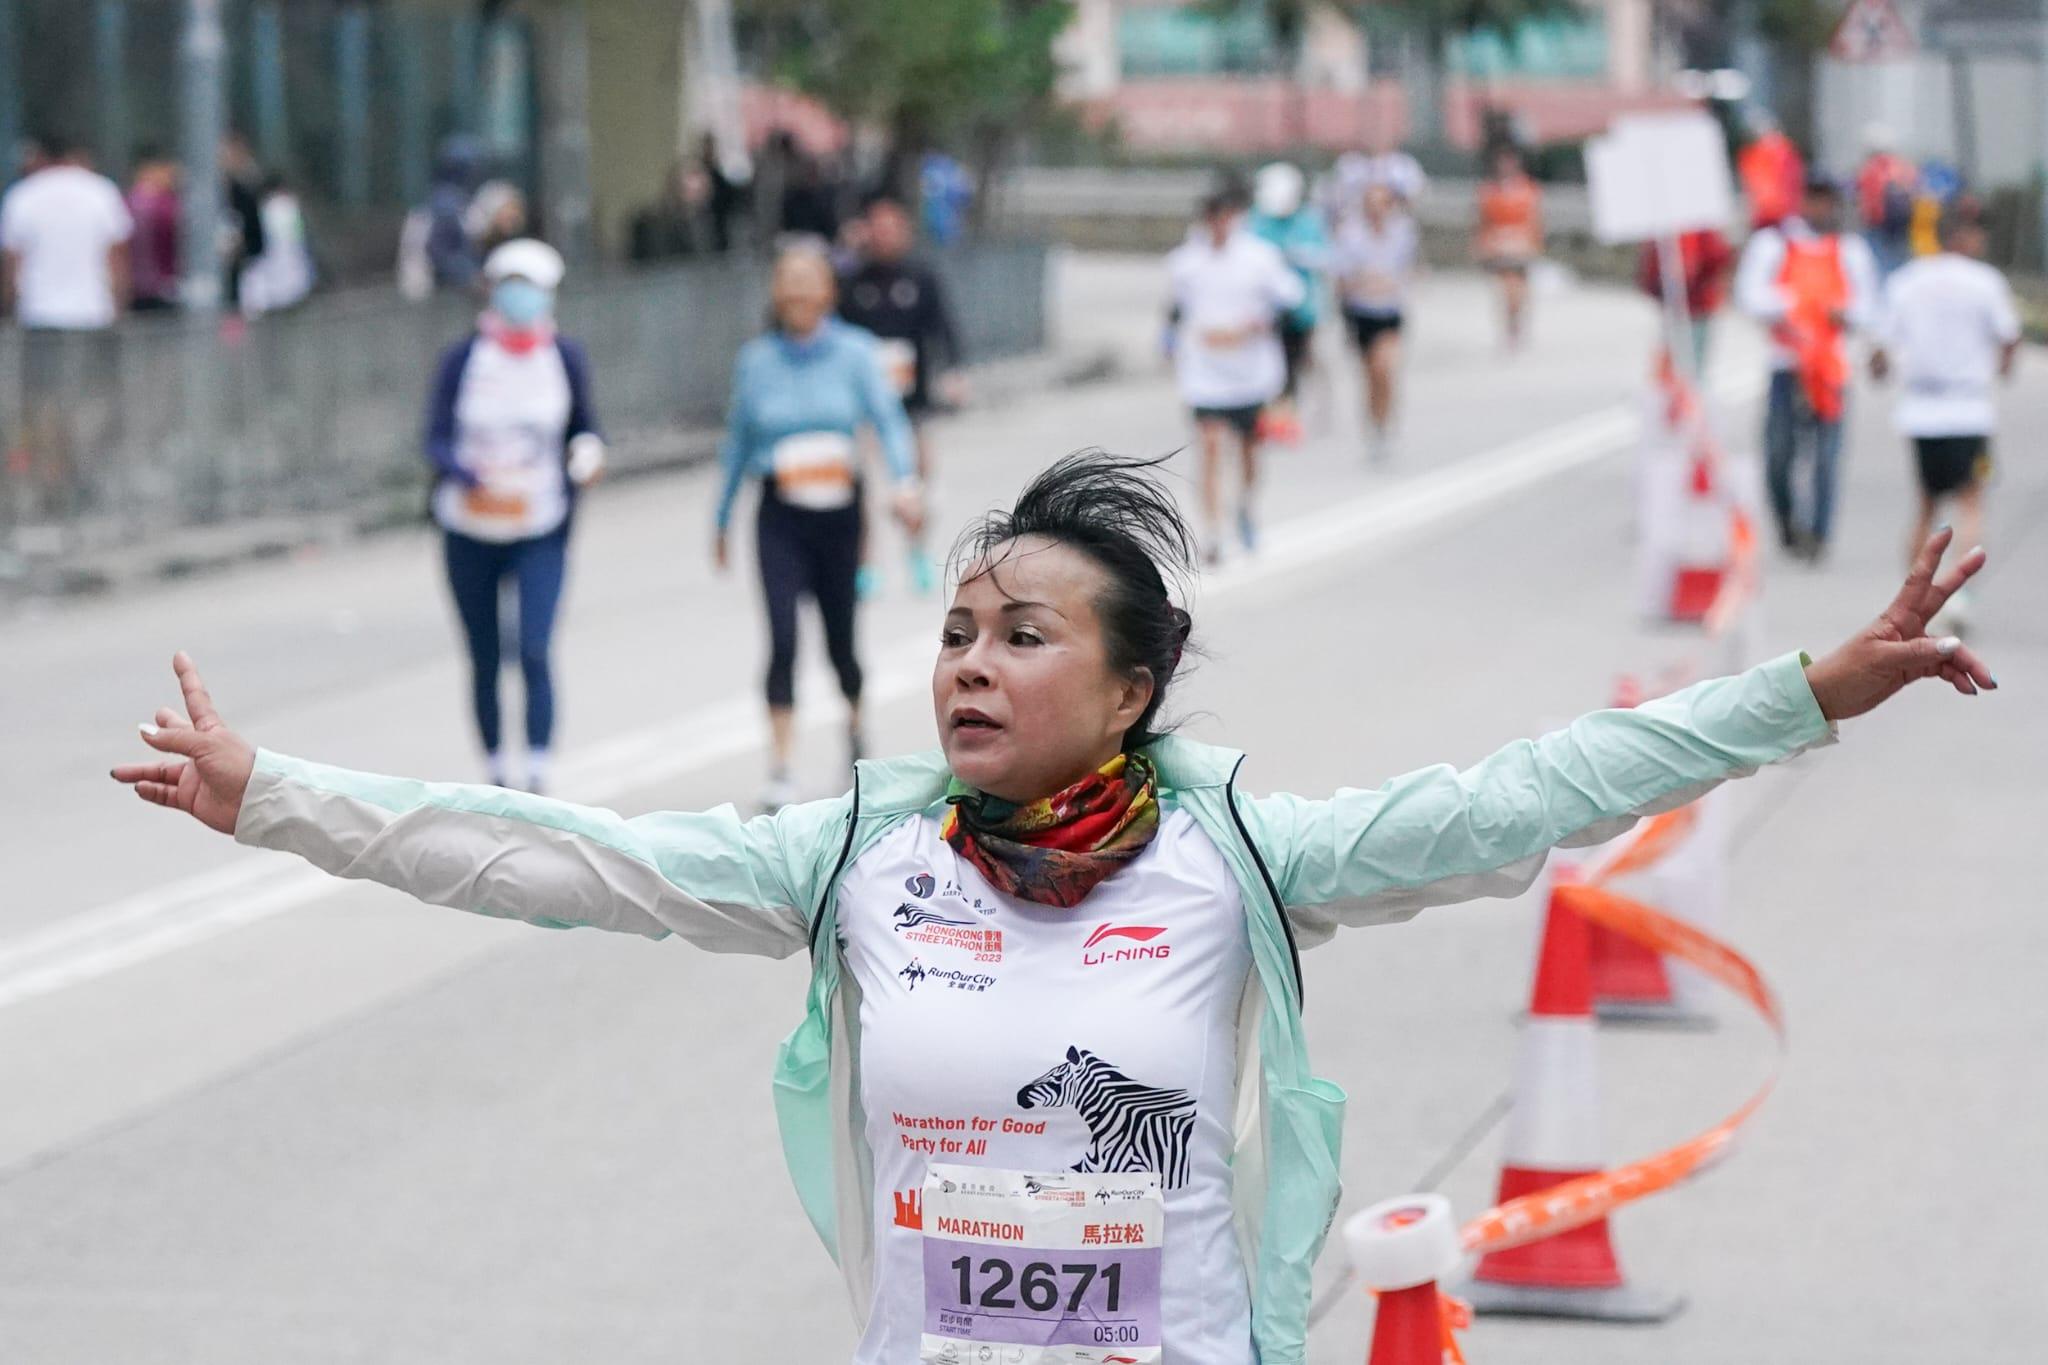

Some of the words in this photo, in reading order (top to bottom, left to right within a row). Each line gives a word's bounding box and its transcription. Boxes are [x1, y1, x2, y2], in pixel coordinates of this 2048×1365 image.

[905, 932, 982, 952] STREETATHON
[925, 924, 983, 941] HONGKONG
[974, 953, 1002, 963] 2023
[1083, 945, 1171, 965] LI-NING
[927, 966, 997, 987] RunOurCity
[893, 1111, 965, 1130] Marathon
[971, 1116, 997, 1131] for
[1002, 1118, 1046, 1135] Good
[901, 1134, 935, 1155] Party
[940, 1137, 962, 1153] for
[965, 1139, 987, 1156] All
[938, 1216, 1024, 1241] MARATHON
[1082, 1223, 1144, 1245] 馬拉松
[951, 1255, 1121, 1313] 12671
[1094, 1326, 1139, 1342] 05:00
